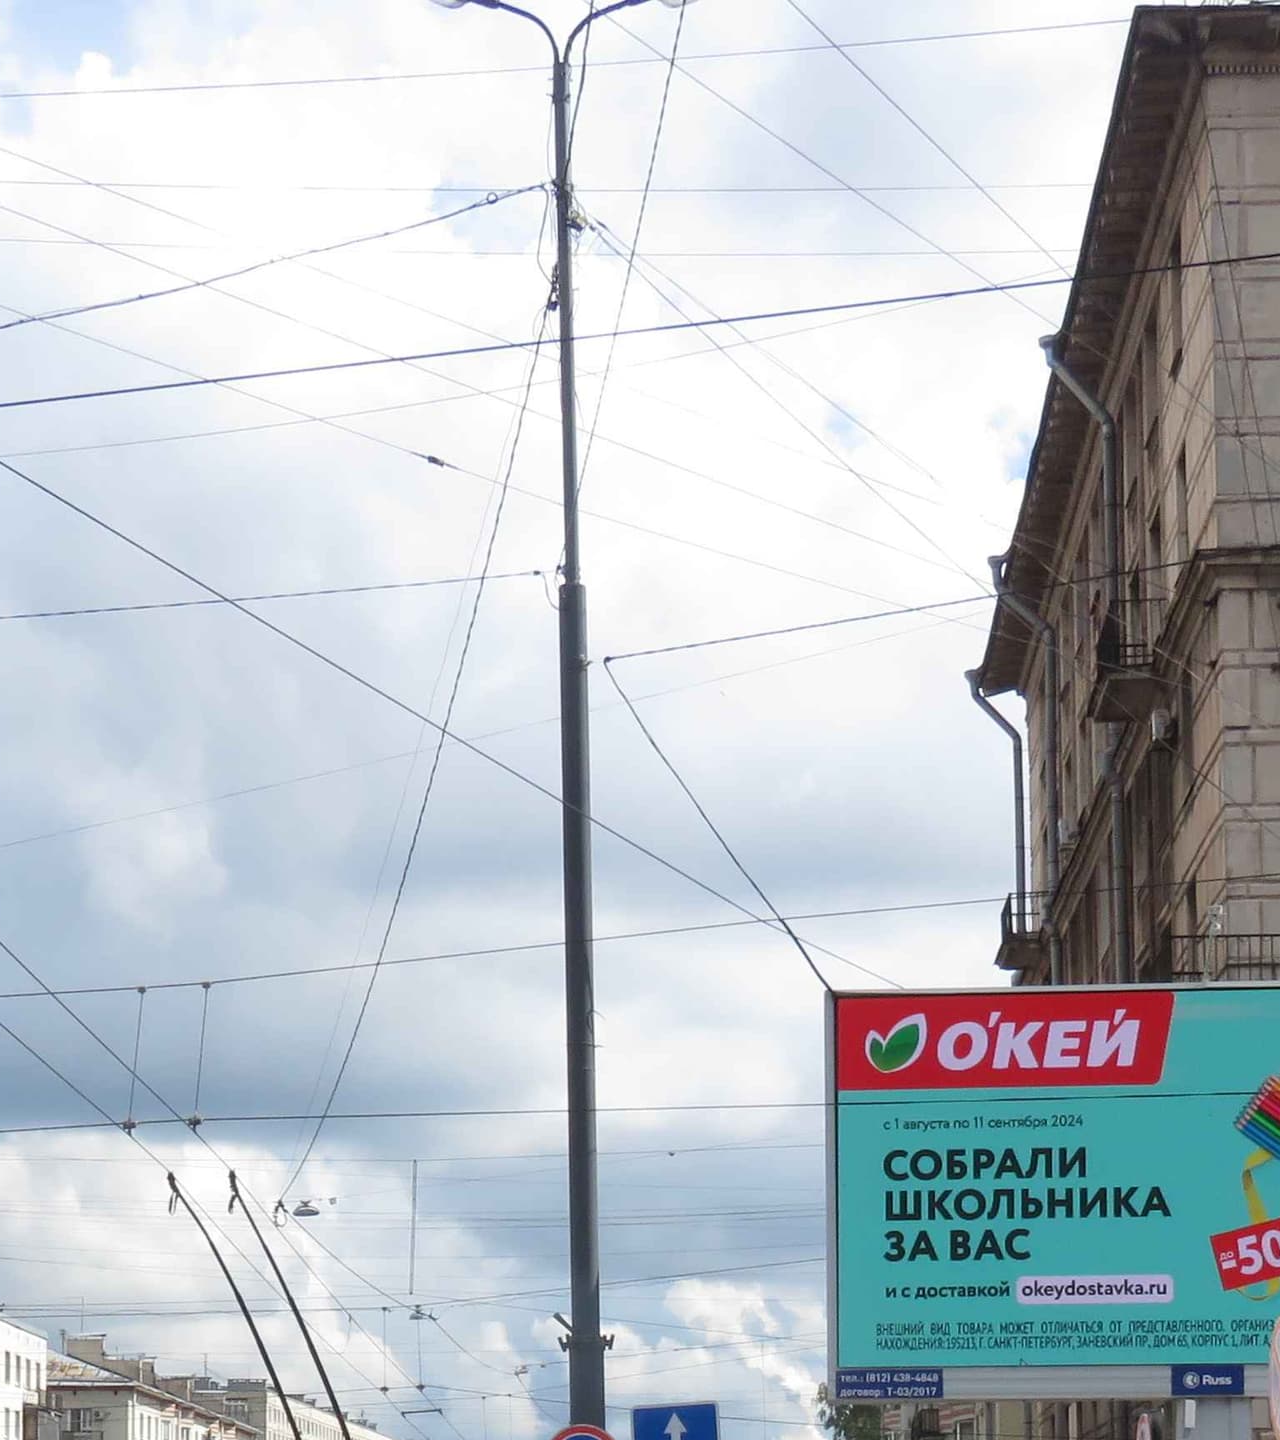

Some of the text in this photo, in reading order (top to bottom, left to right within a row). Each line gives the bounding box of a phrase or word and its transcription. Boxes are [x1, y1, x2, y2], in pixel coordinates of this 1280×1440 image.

[883, 1121, 891, 1130] с
[903, 1120, 950, 1132] августа
[953, 1119, 970, 1129] по
[974, 1116, 984, 1129] 11
[988, 1115, 1048, 1128] сентября
[1051, 1114, 1084, 1128] 2024
[883, 1147, 1087, 1181] СОБРАЛИ
[885, 1186, 1172, 1221] ШКОЛЬНИКА
[883, 1228, 1031, 1262] ЗА ВАС
[885, 1281, 1010, 1299] и с доставкой
[1021, 1279, 1167, 1300] okeydostavka.ru
[876, 1321, 924, 1336] ВНЕШНИЙ
[930, 1322, 951, 1336] ВИД
[957, 1322, 994, 1335] ТОВАРА
[1000, 1321, 1034, 1334] МОЖЕТ
[1041, 1320, 1103, 1334] ОТЛИЧАТЬСЯ
[1109, 1320, 1122, 1333] ОТ
[1128, 1319, 1225, 1334] ПРЕДСТАВЛЕННОГО.
[1076, 1333, 1133, 1348] ЗАНЕВСКИЙ
[1153, 1334, 1175, 1348] ДОМ
[1191, 1334, 1229, 1347] КОРПУС
[865, 1372, 891, 1384] (812)
[893, 1372, 939, 1383] 438-4848
[1202, 1374, 1232, 1385] Russ
